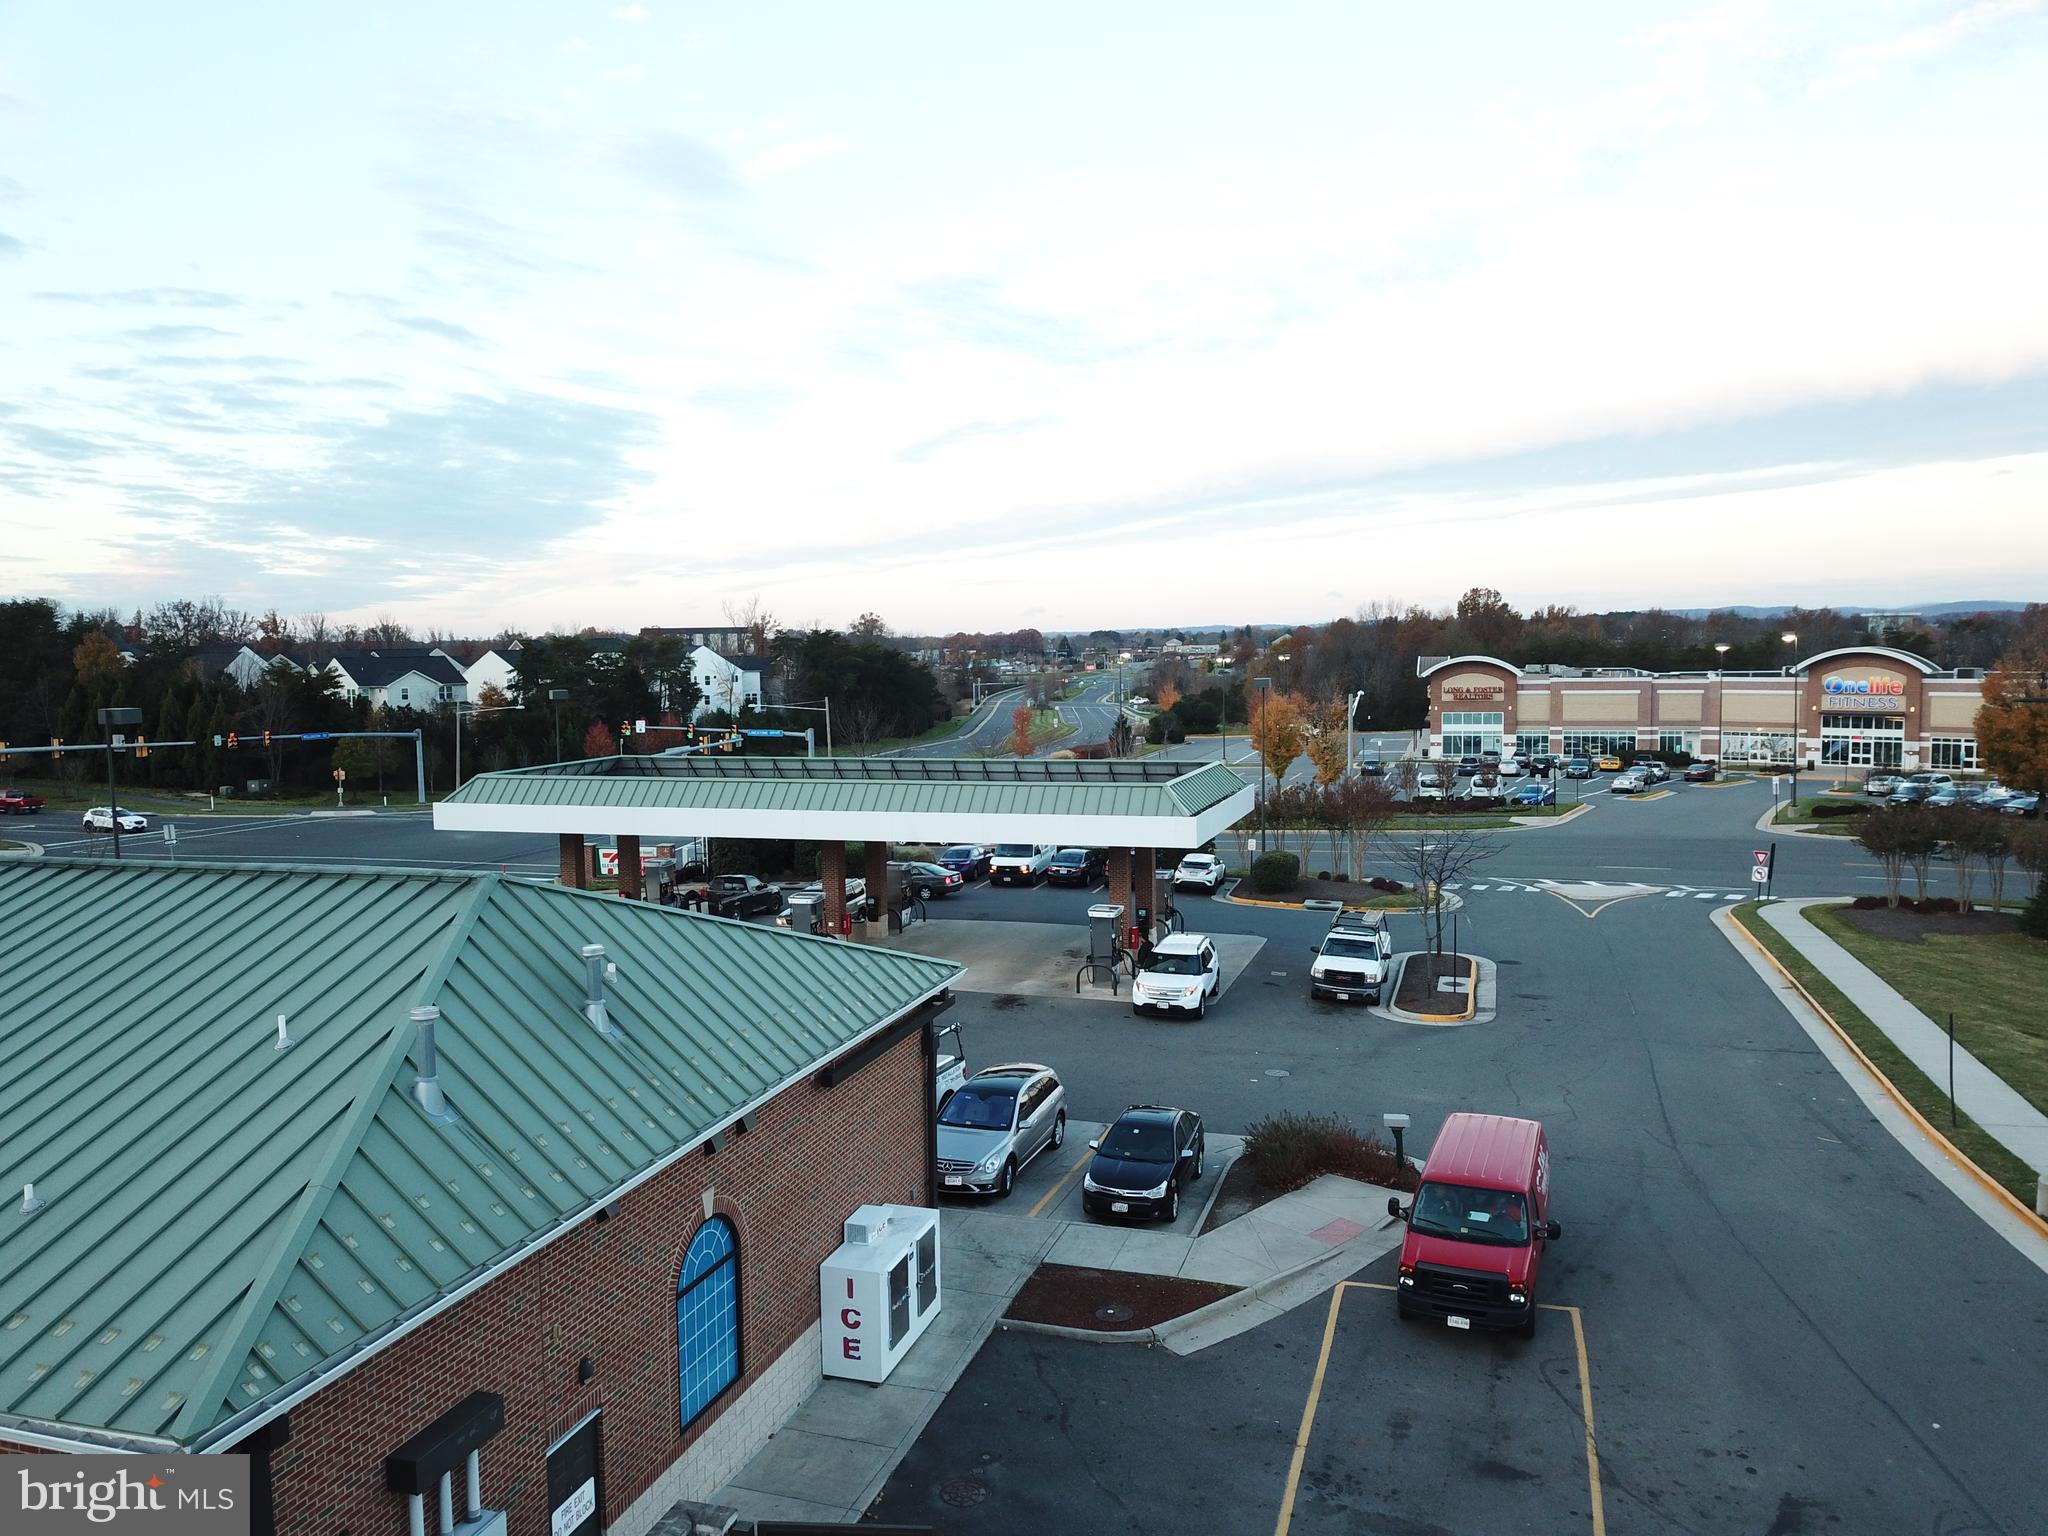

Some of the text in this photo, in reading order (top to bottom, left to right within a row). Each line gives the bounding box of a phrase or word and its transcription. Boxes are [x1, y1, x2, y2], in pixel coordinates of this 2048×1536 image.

[1825, 676, 1903, 695] Onelife
[1828, 696, 1898, 709] FITNESS
[841, 1277, 862, 1361] ICE
[561, 1490, 585, 1520] FIRE EXIT
[564, 1514, 574, 1533] NOT
[576, 1497, 594, 1520] BLOCK
